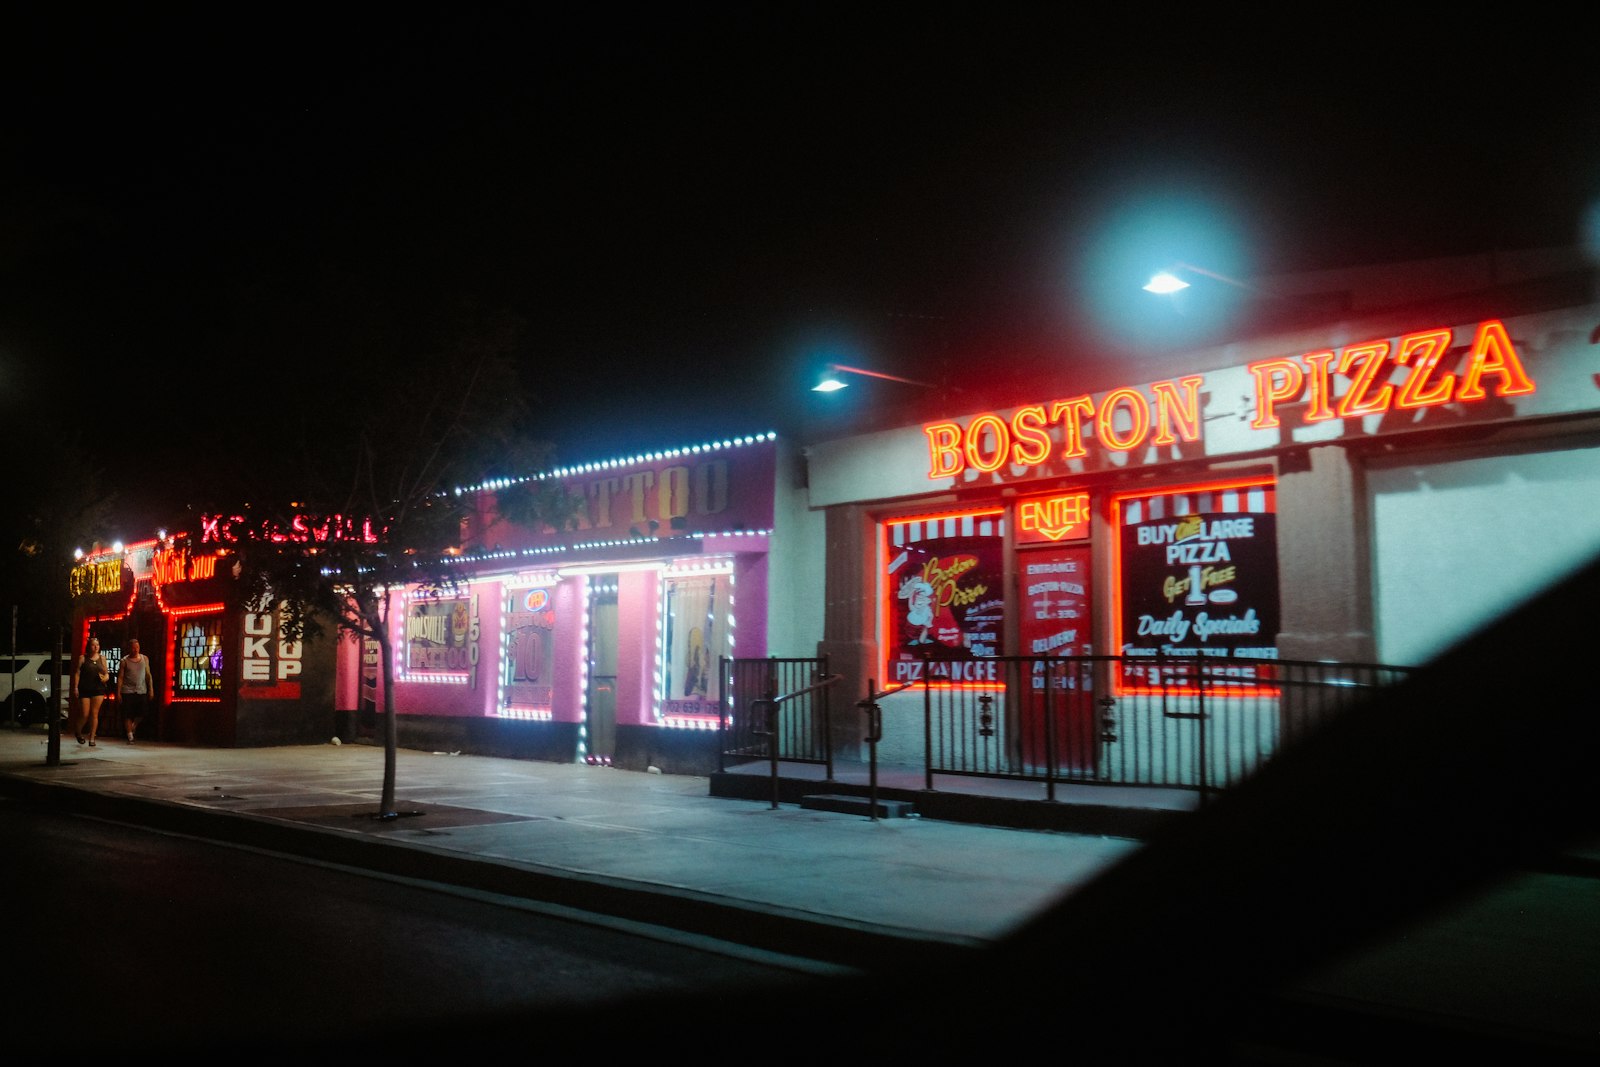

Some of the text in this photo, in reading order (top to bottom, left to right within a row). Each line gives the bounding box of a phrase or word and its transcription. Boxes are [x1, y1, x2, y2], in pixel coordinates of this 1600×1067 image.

[925, 376, 1204, 480] BOSTON
[1249, 319, 1535, 431] PIZZA
[540, 460, 728, 534] ATTOO
[1020, 495, 1090, 530] ENTER
[200, 514, 390, 544] KOLSVILL
[1137, 524, 1178, 545] BUY
[1199, 517, 1254, 540] LARGE
[1166, 541, 1231, 565] PIZZA
[922, 556, 979, 588] Boston
[242, 570, 275, 680] OKE
[278, 599, 304, 680] OP
[406, 615, 448, 646] KOOLSVILLE
[469, 593, 481, 690] 1501
[1137, 608, 1261, 643] Daily Specials
